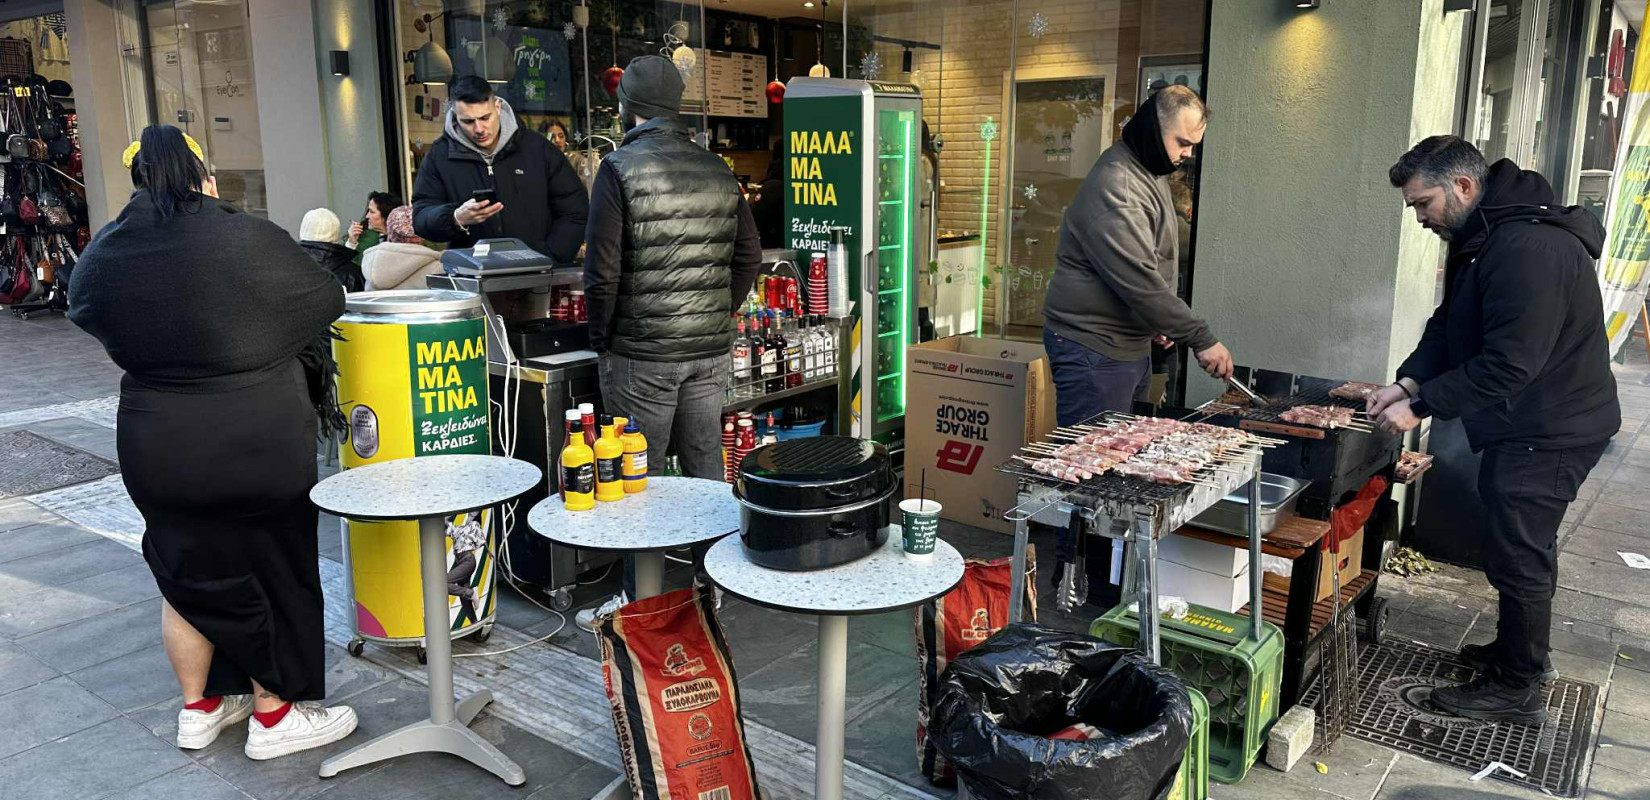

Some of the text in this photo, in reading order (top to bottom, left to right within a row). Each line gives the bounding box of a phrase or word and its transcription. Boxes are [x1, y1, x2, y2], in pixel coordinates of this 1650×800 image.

[791, 131, 852, 155] ΜΑΛΑ
[791, 157, 823, 180] ΜΑ
[791, 182, 838, 206] ΤΙΝΑ
[792, 239, 830, 250] ΚΑΡΔΙΕ
[416, 335, 486, 366] ΜΑΛΑ
[418, 364, 463, 390] ΜΑ
[419, 385, 479, 414] ΤΙΝΑ
[936, 404, 990, 426] GROUP
[936, 419, 989, 441] THRACE
